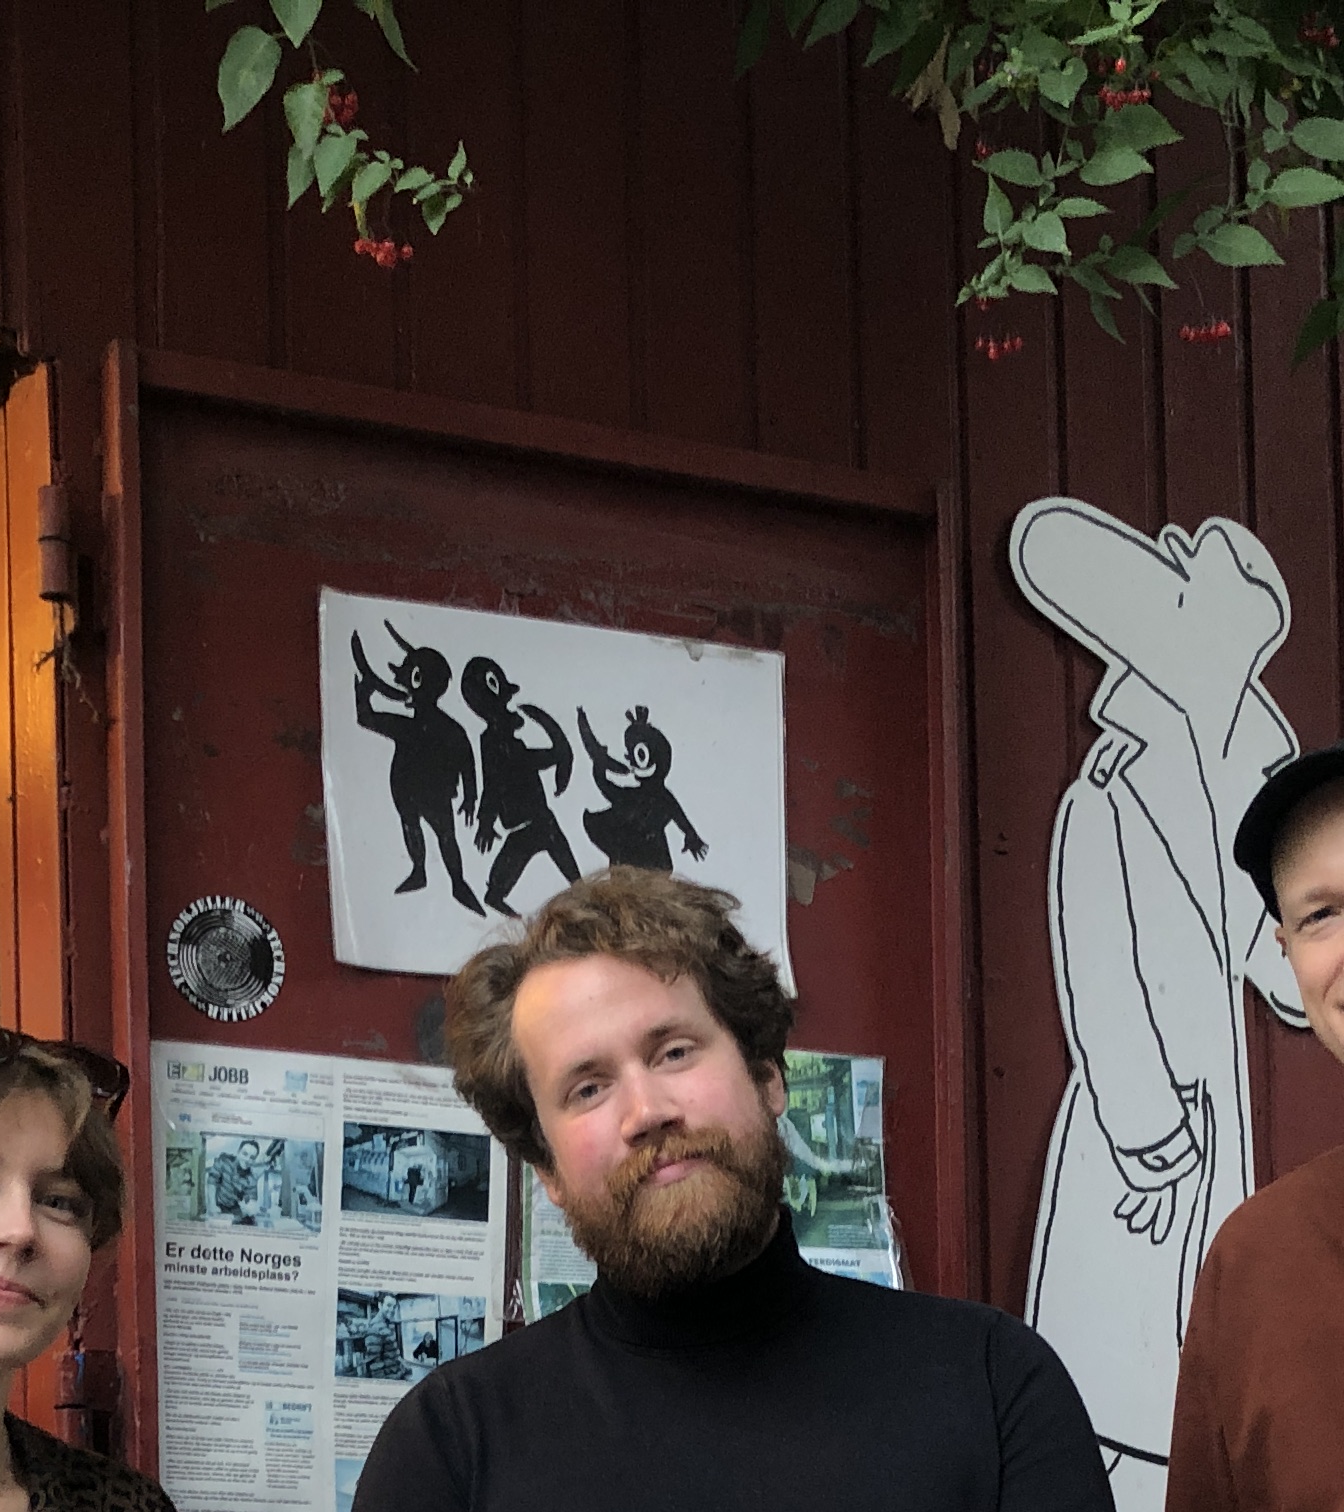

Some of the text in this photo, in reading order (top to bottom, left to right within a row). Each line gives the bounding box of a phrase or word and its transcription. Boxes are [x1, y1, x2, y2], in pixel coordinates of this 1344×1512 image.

[208, 1065, 249, 1085] JOBB
[165, 1242, 302, 1269] Er dette Norges
[164, 1262, 299, 1282] minste arbeidsplass?
